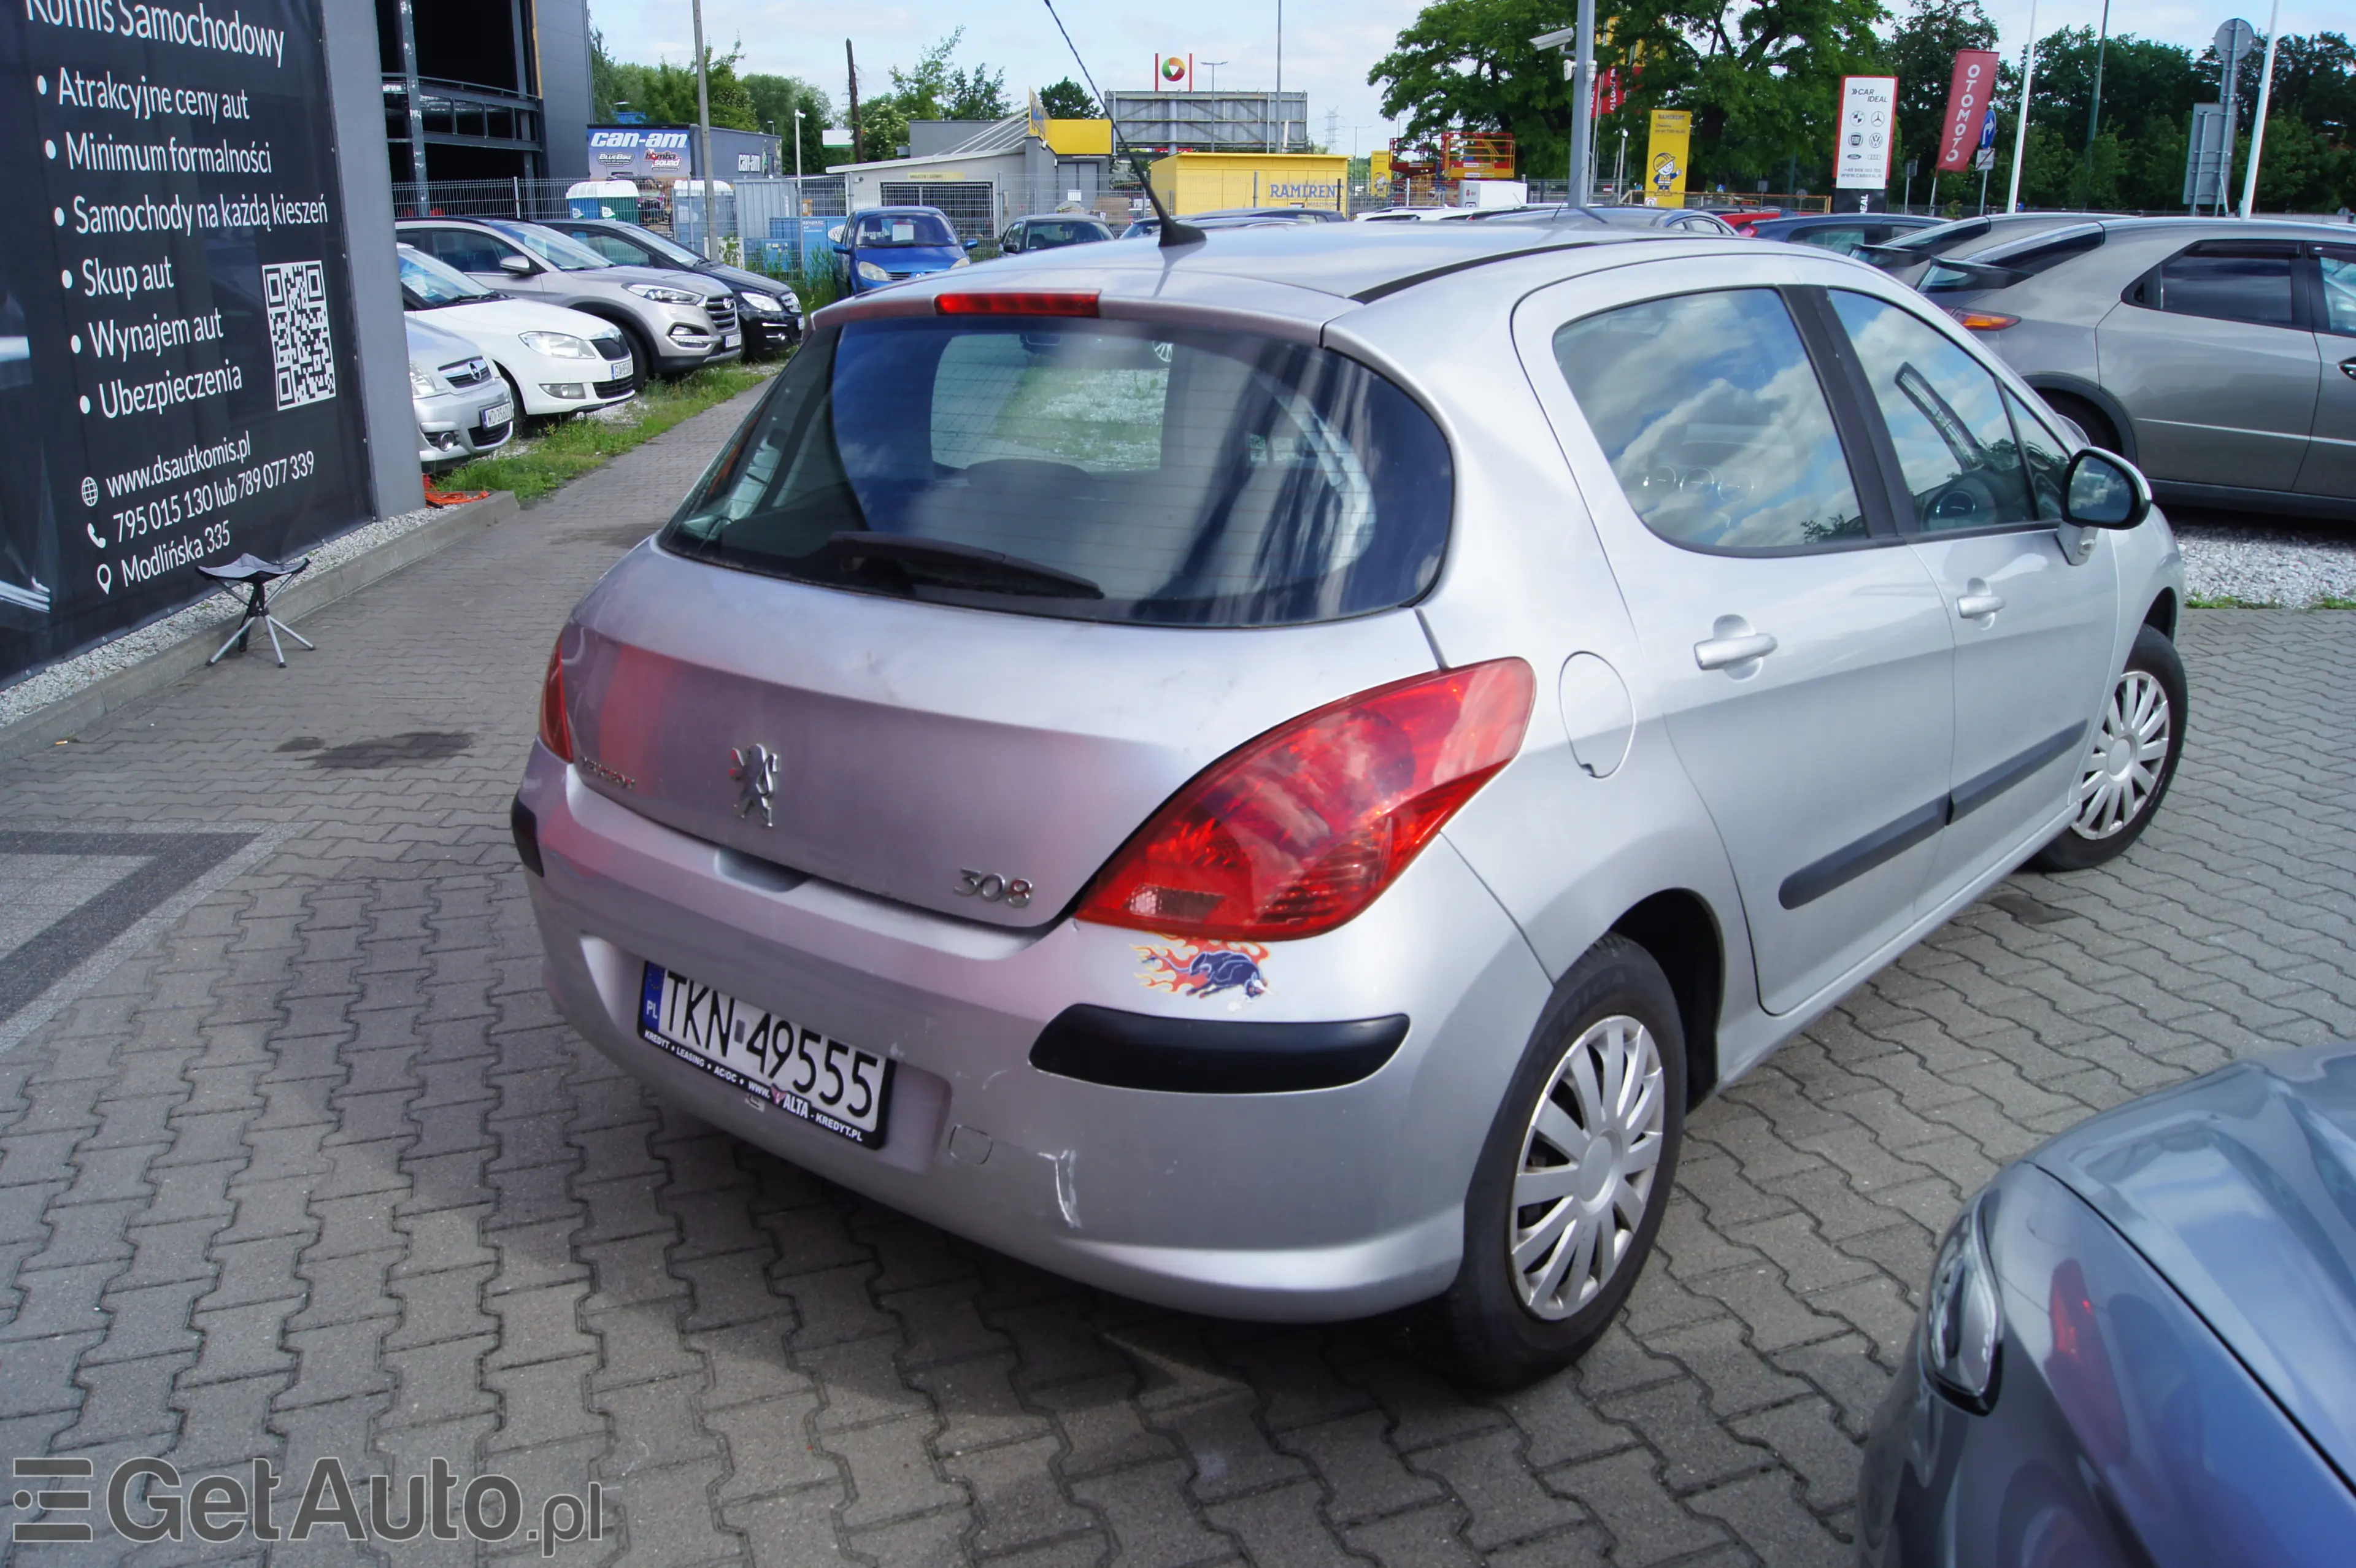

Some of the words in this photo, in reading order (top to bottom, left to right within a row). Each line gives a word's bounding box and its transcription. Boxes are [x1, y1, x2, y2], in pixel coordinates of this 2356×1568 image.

[120, 0, 285, 67] Samochodowy
[59, 67, 172, 120] Atrakcyjne
[176, 86, 218, 123] ceny
[223, 89, 250, 120] aut
[1946, 64, 1981, 161] OTOMOTO
[66, 131, 167, 172] Minimum
[169, 136, 272, 174] formalności
[591, 133, 687, 148] can-am
[738, 153, 760, 172] can-am
[73, 194, 192, 236] Samochody
[197, 204, 218, 228] na
[220, 193, 272, 232] każdą
[274, 193, 328, 226] kieszeń
[1269, 184, 1344, 198] RAMIRENT
[82, 257, 138, 300] Skup
[142, 255, 174, 289] aut
[88, 313, 191, 362] Wynajem
[194, 307, 224, 342] aut
[99, 358, 242, 418] Ubezpieczenia
[106, 430, 251, 499] www.dsautkomis.pl
[113, 506, 147, 543] 795
[149, 494, 181, 531] 015
[183, 485, 214, 517] 130
[214, 478, 237, 509] lub
[237, 470, 261, 499] 789
[263, 459, 288, 489] 077
[290, 450, 315, 480] 339
[120, 536, 204, 588] Modlińska
[206, 520, 231, 554] 335
[953, 866, 1033, 909] 308
[646, 999, 658, 1019] PL
[668, 970, 735, 1058] TKN
[745, 1012, 878, 1118] 49555
[644, 1029, 670, 1050] KREDYT
[676, 1048, 705, 1068] LEASING
[714, 1066, 737, 1083] AC/OC
[748, 1080, 771, 1099] WWW.
[783, 1094, 809, 1119] ALTA
[815, 1113, 863, 1142] KREDYT.PL
